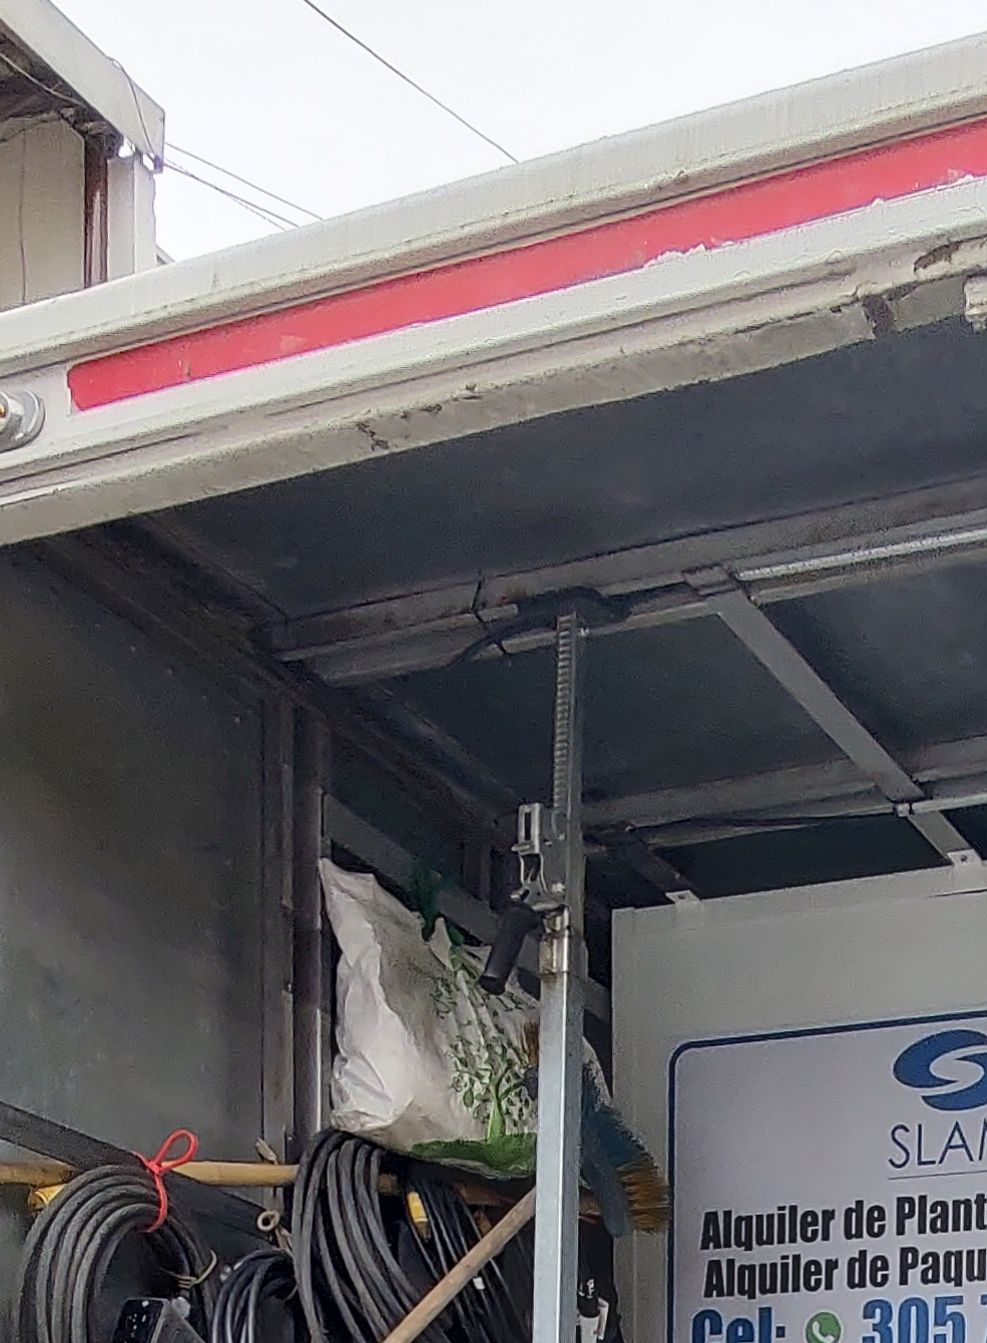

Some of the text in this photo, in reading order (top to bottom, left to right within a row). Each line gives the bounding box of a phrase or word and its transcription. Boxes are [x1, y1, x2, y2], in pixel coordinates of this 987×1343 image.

[700, 1204, 836, 1252] Alquiler
[844, 1199, 886, 1240] de
[703, 1254, 839, 1300] Alquiler
[847, 1249, 890, 1290] de
